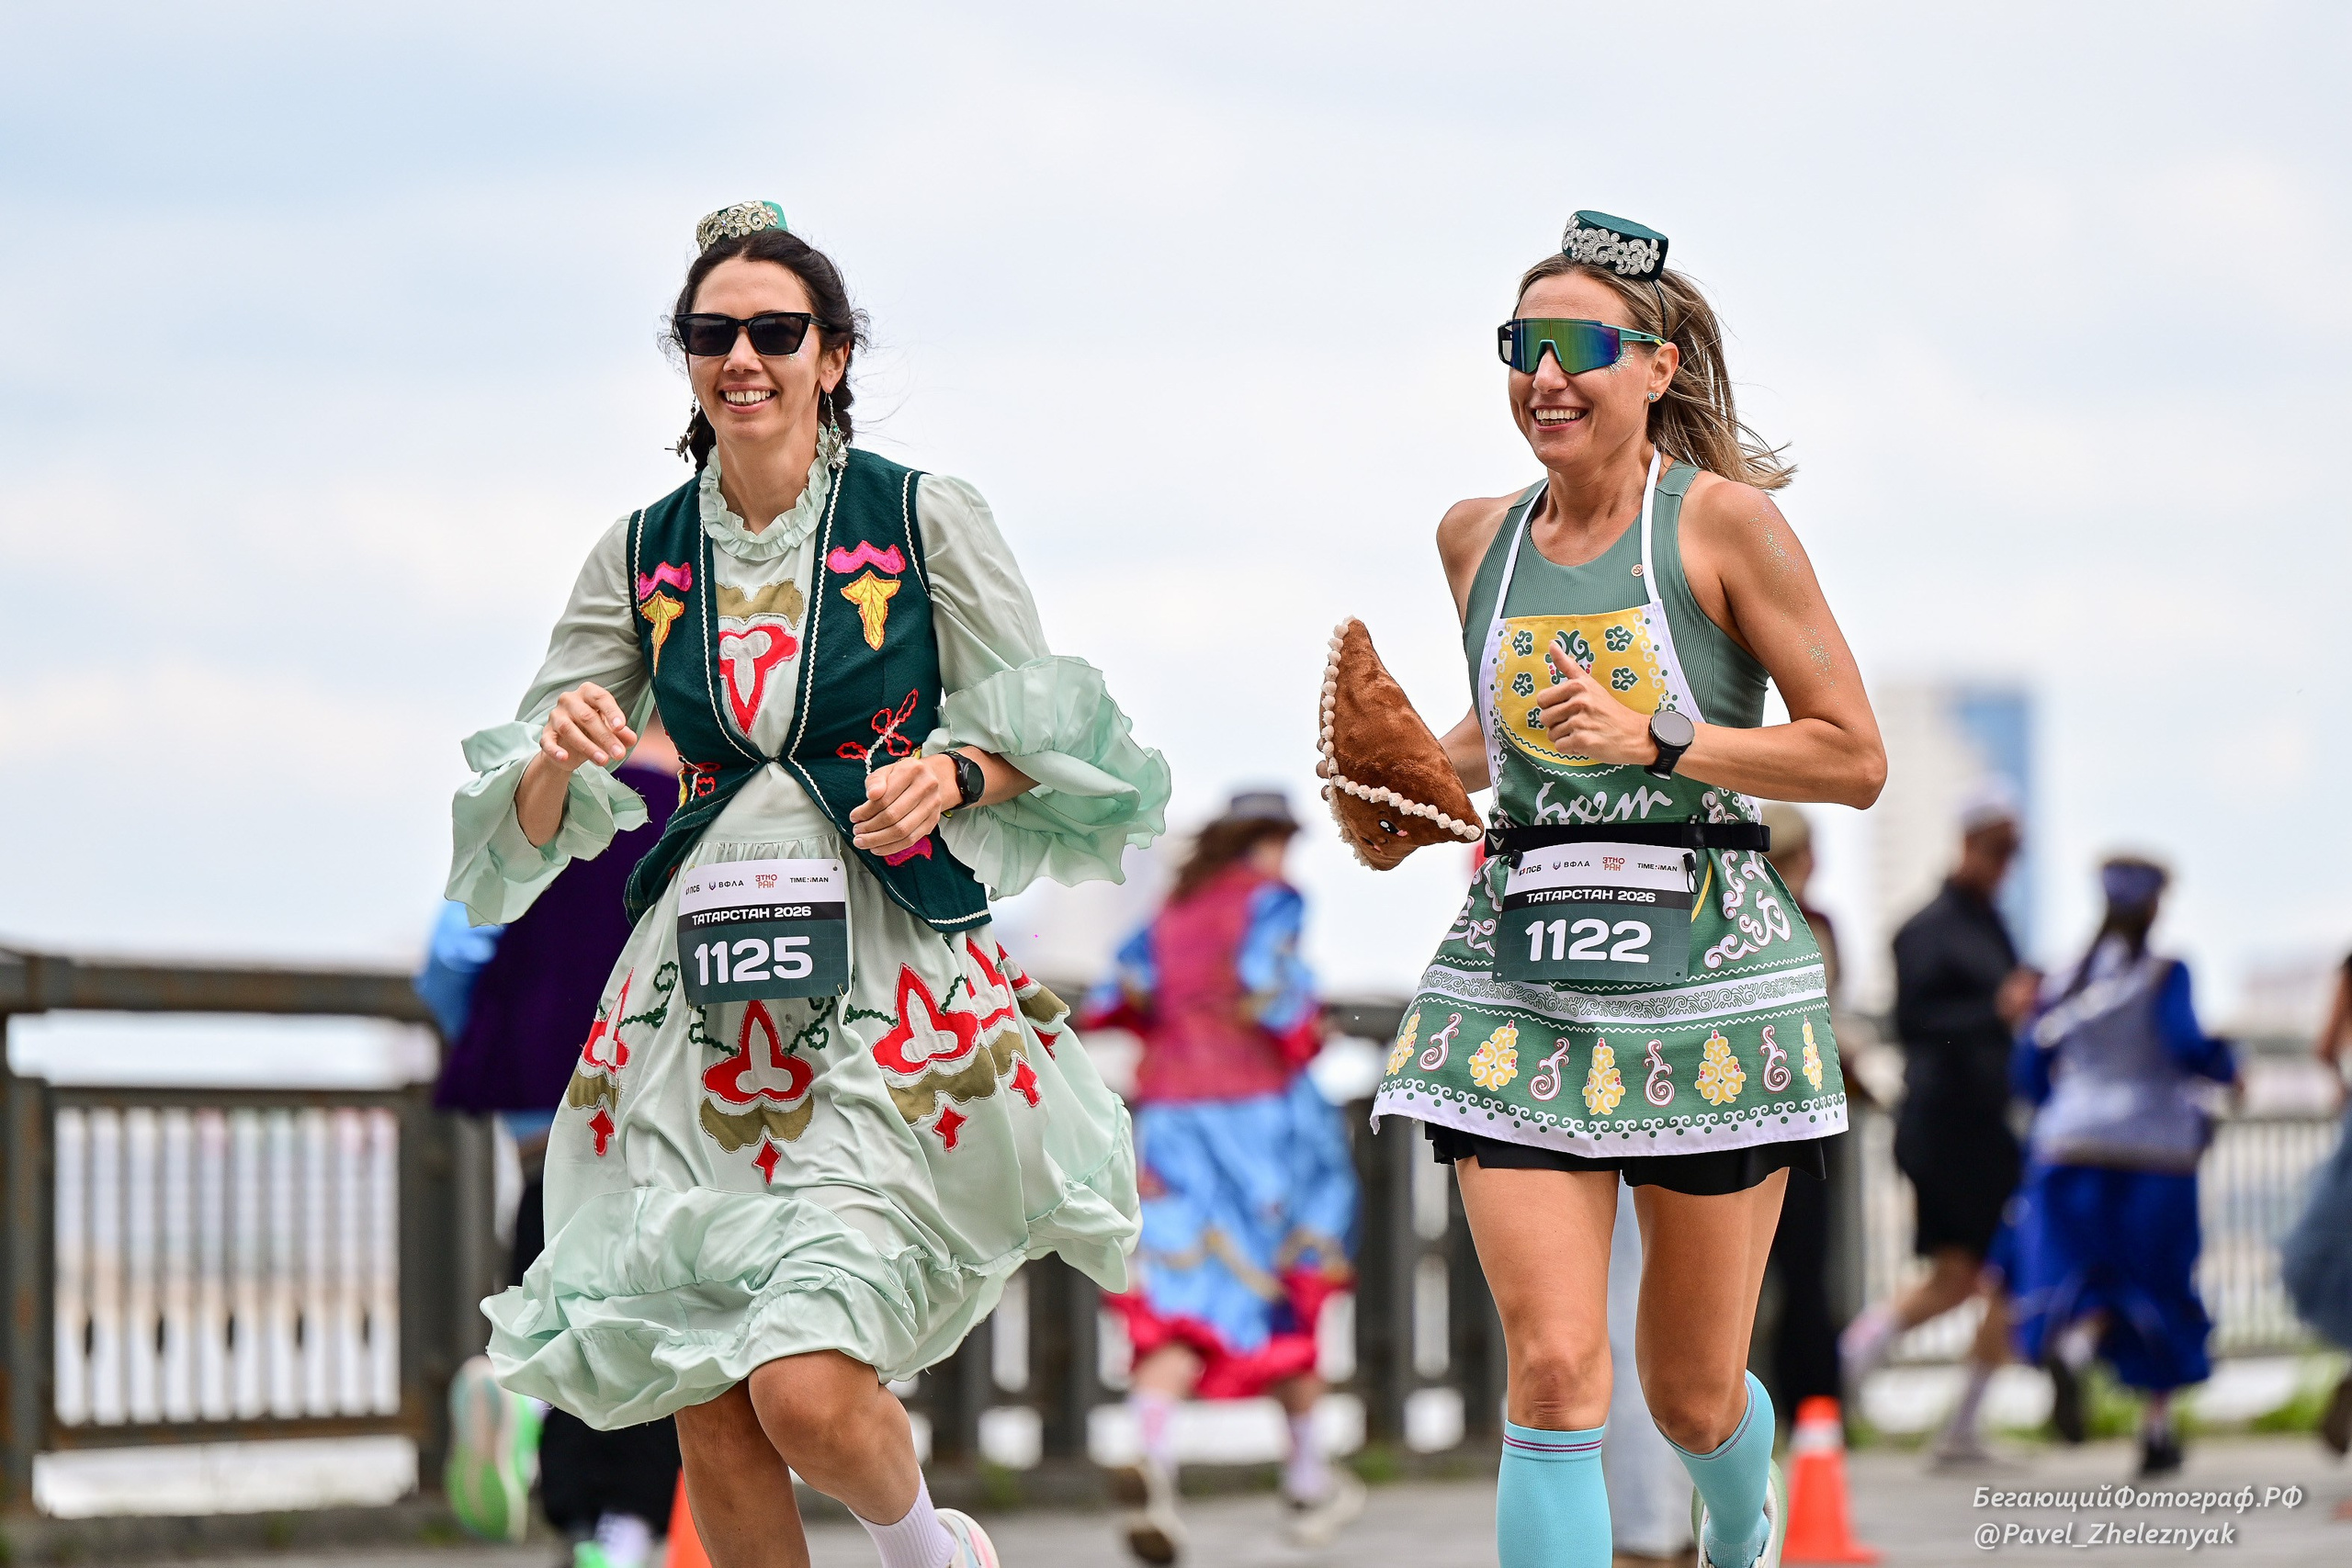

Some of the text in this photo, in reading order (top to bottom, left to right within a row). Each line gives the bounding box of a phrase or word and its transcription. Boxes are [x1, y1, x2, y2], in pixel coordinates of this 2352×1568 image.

[1526, 864, 1542, 874] ПСБ
[718, 880, 744, 888] ВФЛА
[1526, 888, 1657, 904] ТАТАРСТАН 2026
[692, 906, 812, 926] ТАТАРСТАН 2026
[1525, 918, 1652, 964] 1122
[694, 935, 813, 987] 1125
